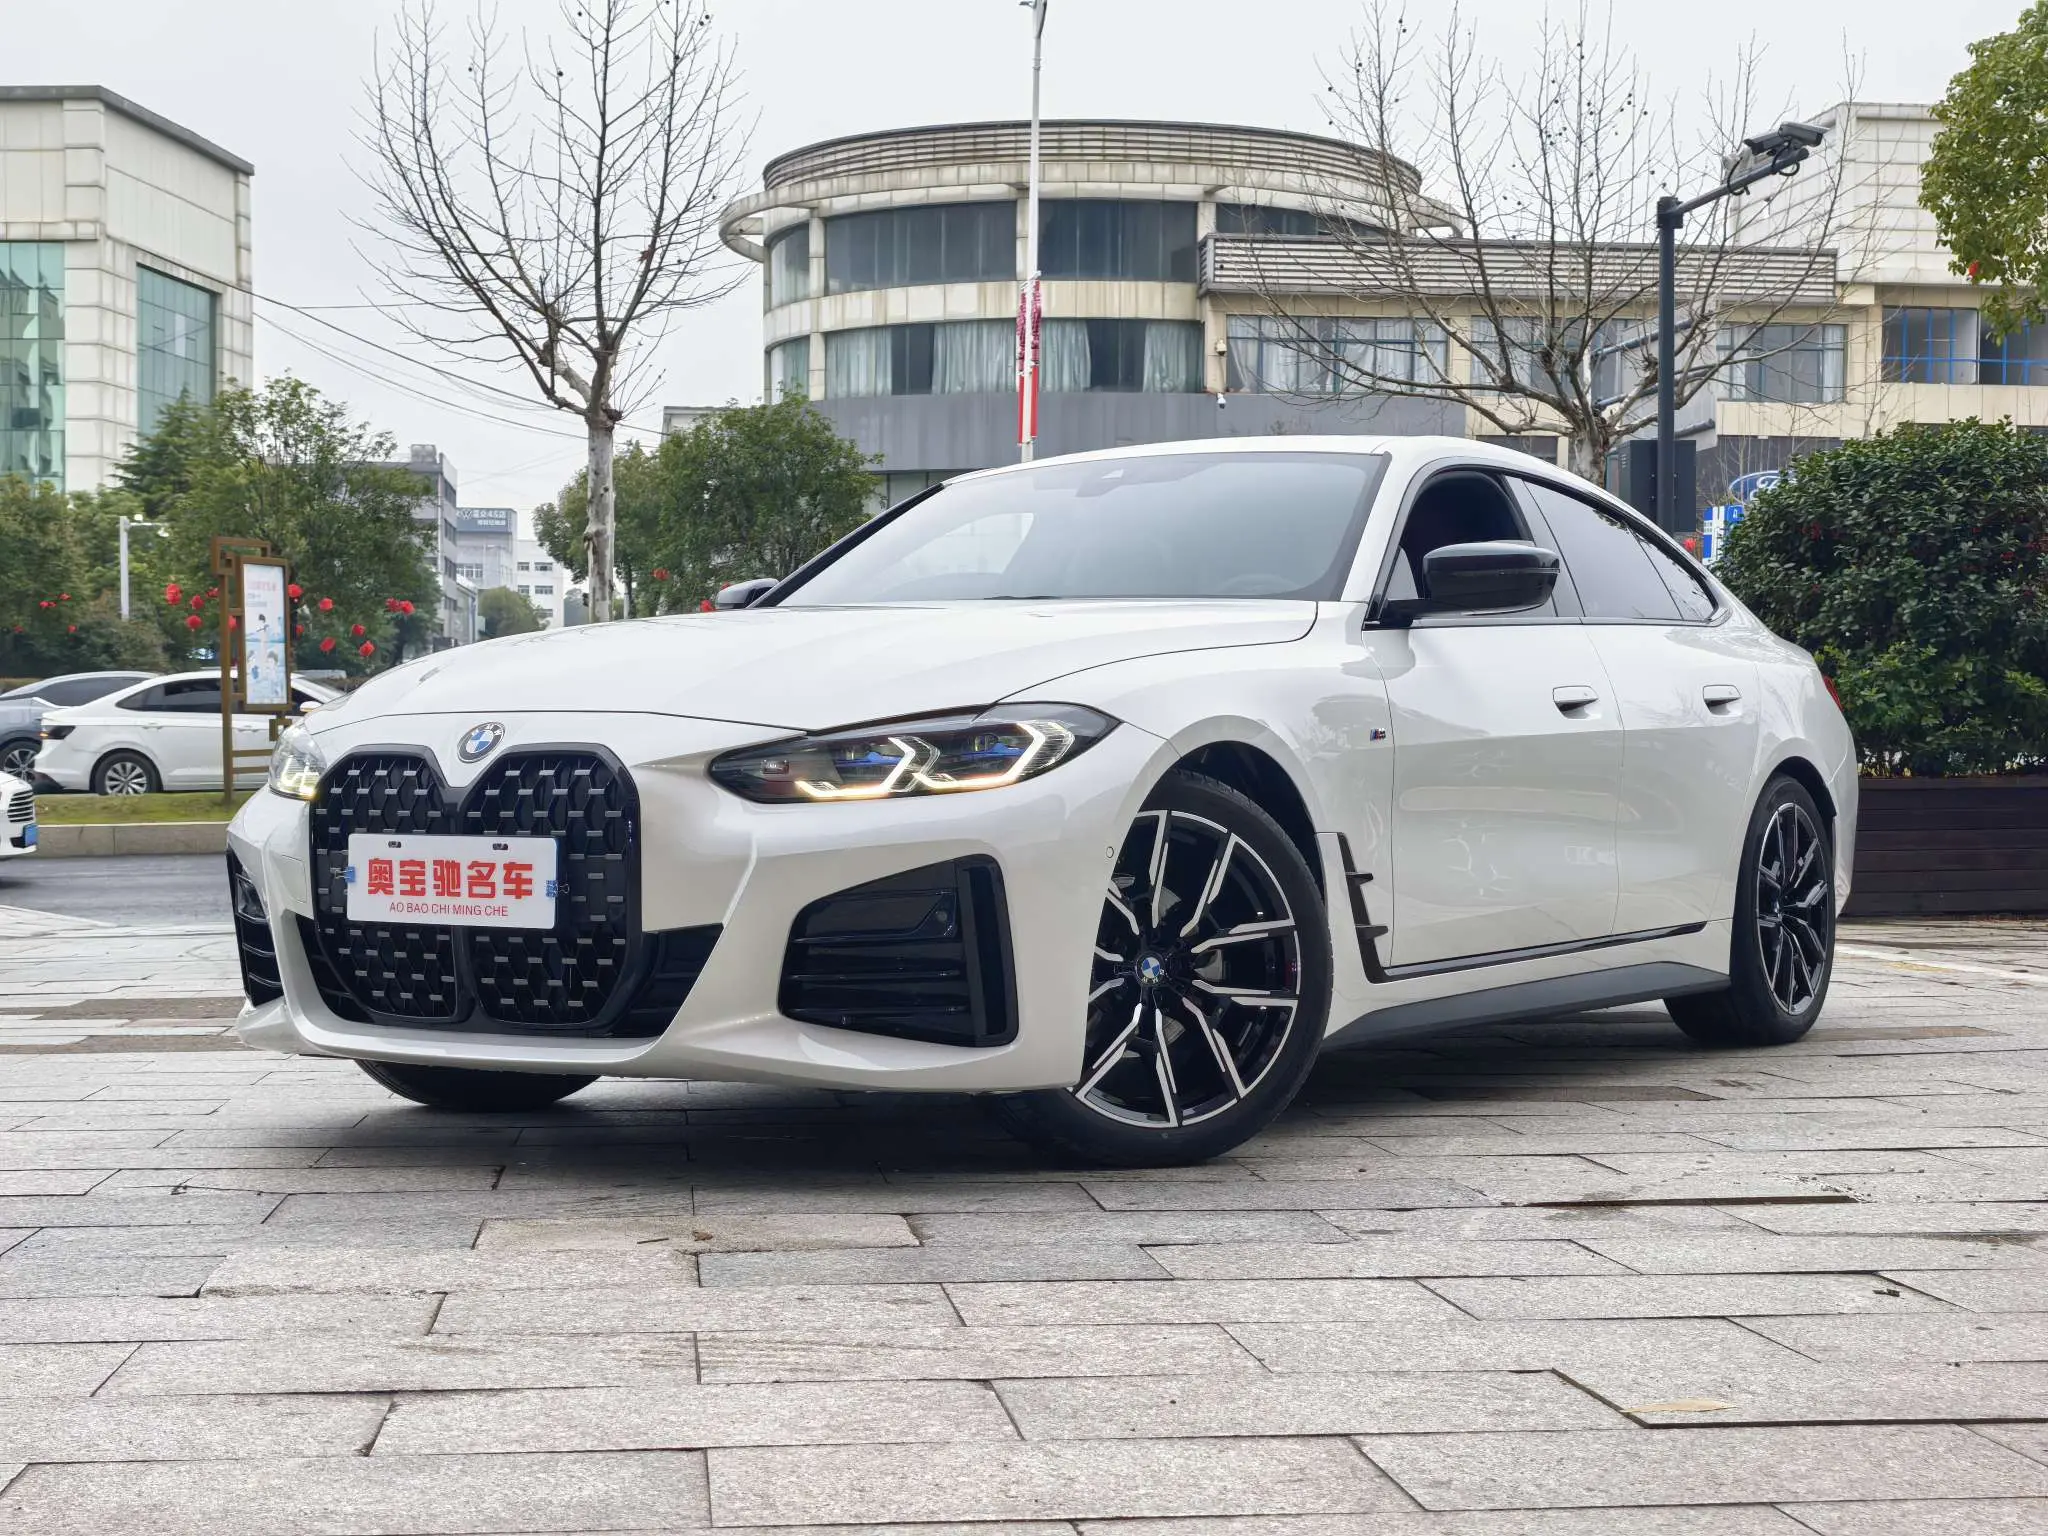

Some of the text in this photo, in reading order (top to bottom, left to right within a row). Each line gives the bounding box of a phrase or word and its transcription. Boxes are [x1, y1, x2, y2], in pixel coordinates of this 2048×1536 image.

[367, 858, 533, 899] 奥宝驰名车
[389, 903, 509, 917] AO BAO CHI MING CHE
